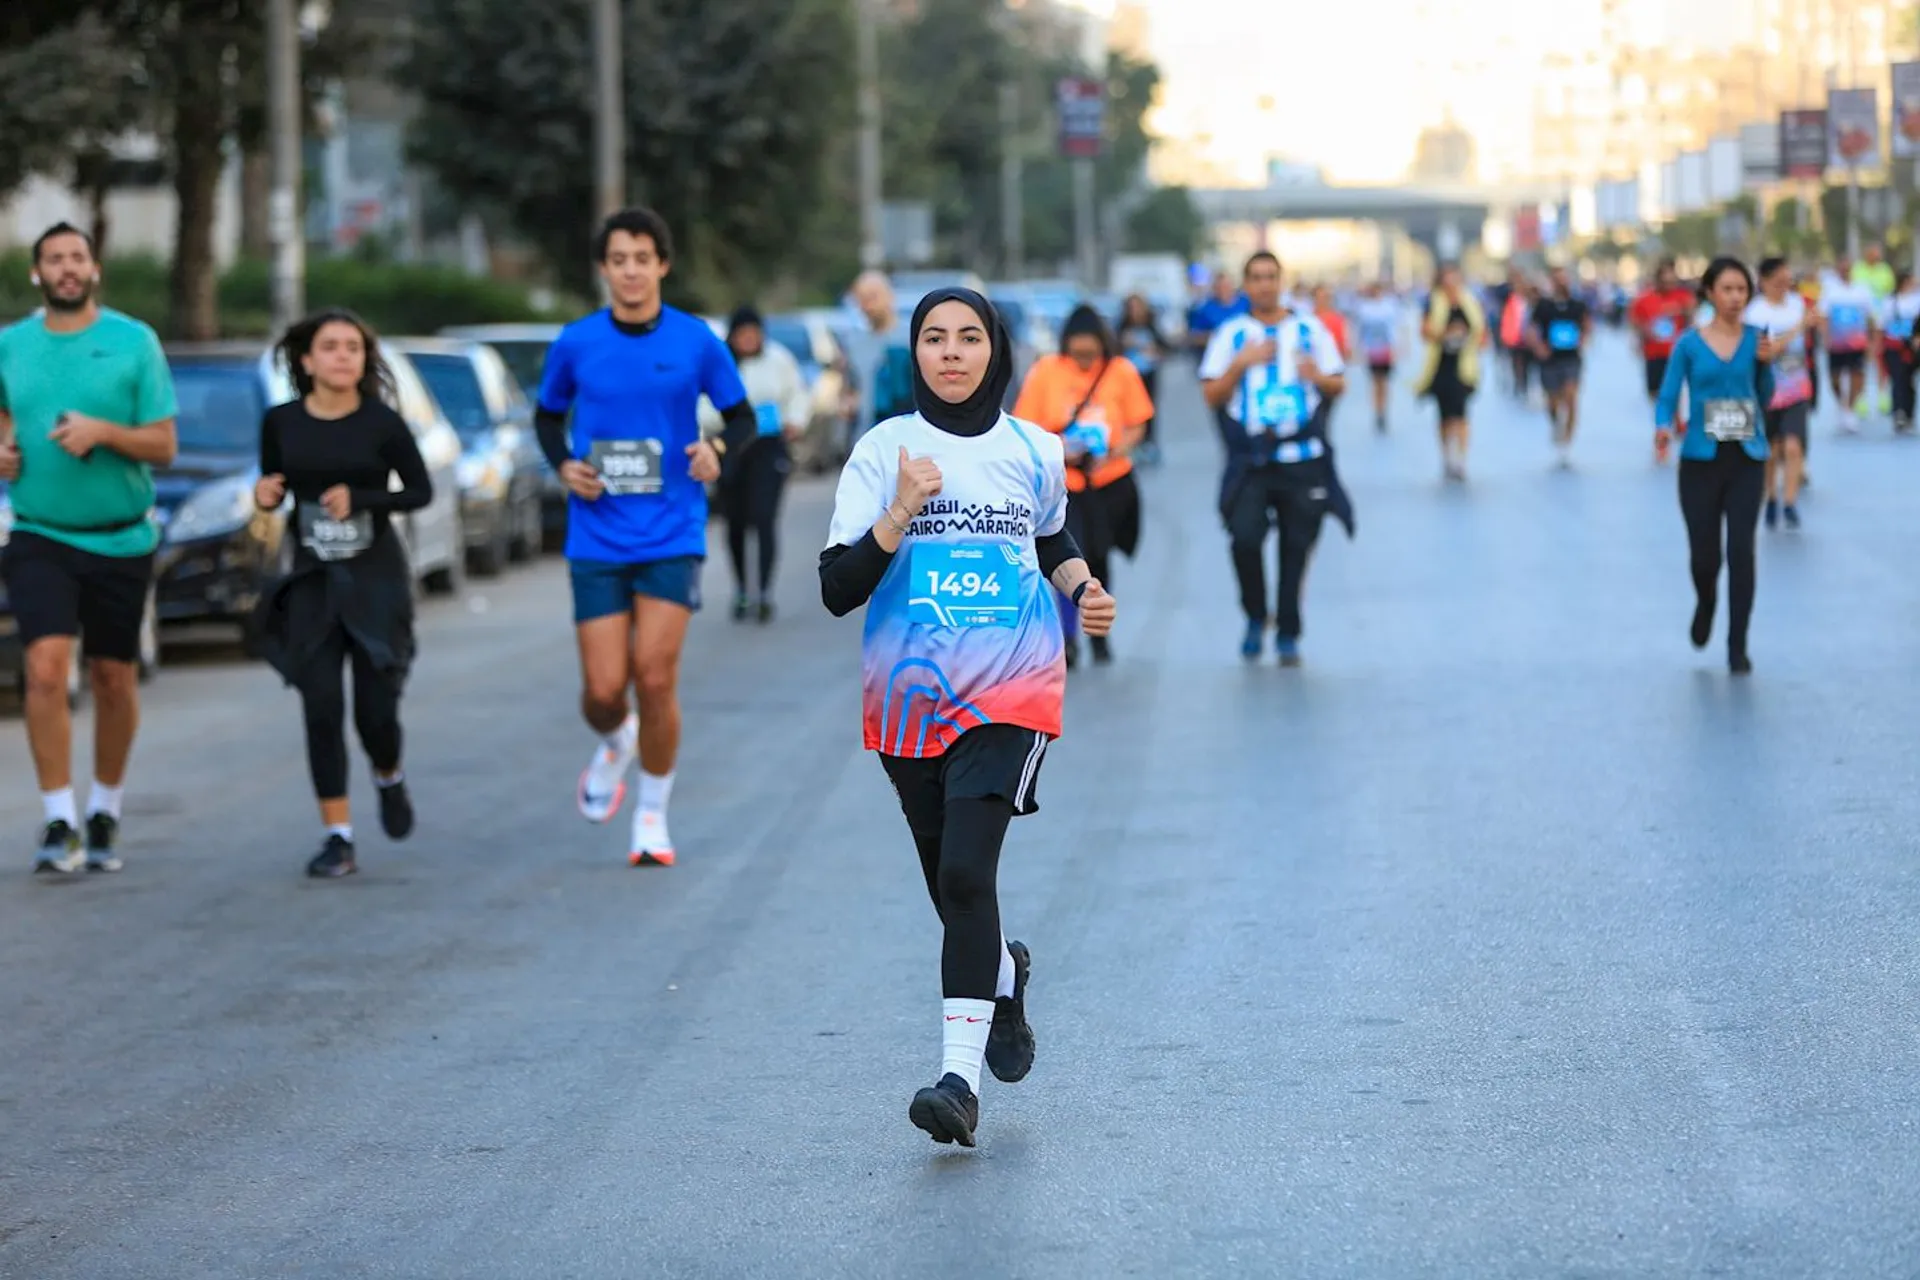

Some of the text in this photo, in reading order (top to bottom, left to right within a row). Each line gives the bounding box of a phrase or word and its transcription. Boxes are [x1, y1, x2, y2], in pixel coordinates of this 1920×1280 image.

[961, 498, 1031, 520] ماراثون
[904, 519, 946, 537] AIRO
[926, 570, 1001, 597] 1494
